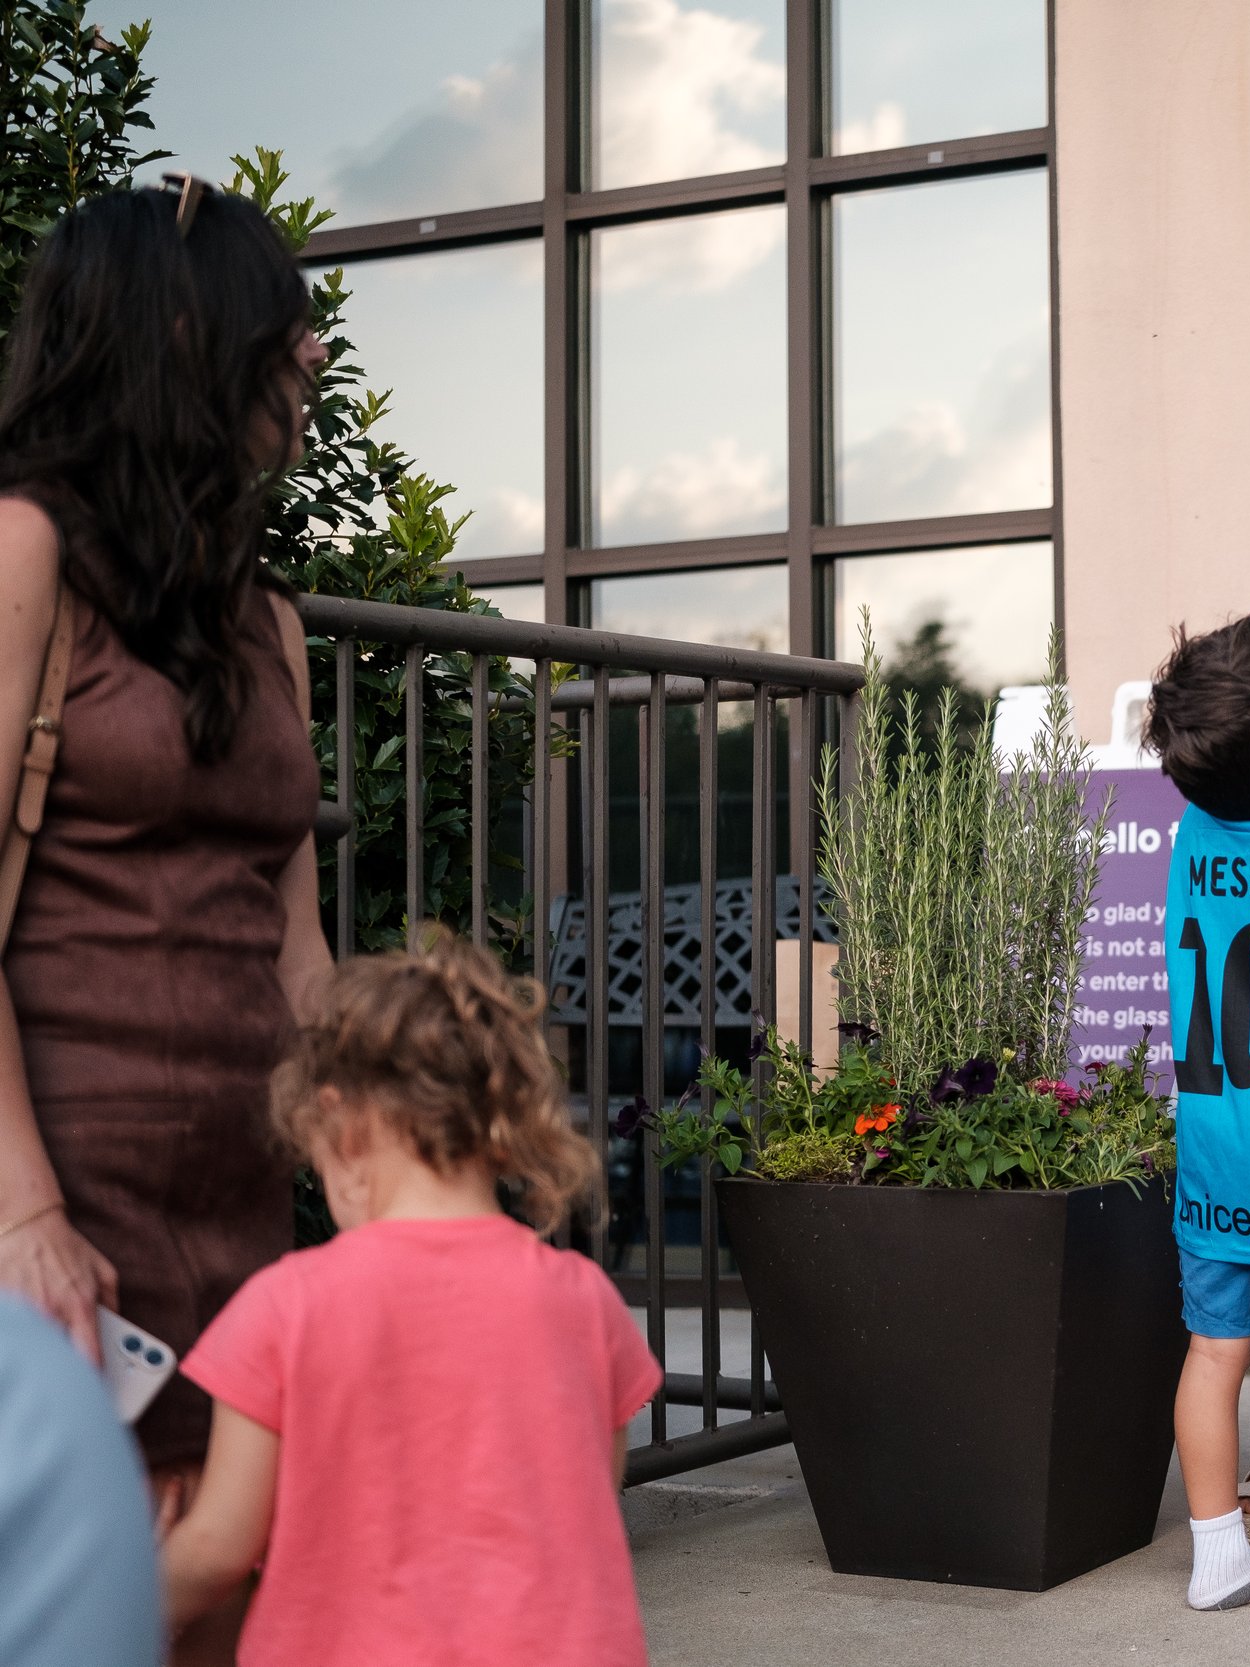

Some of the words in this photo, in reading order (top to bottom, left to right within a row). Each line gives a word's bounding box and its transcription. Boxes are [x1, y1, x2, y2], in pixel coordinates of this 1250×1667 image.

[1103, 902, 1151, 926] glad
[1086, 935, 1104, 957] is
[1107, 937, 1146, 957] not
[1089, 971, 1150, 991] enter
[1113, 1005, 1169, 1030] glass
[1079, 1044, 1128, 1064] your
